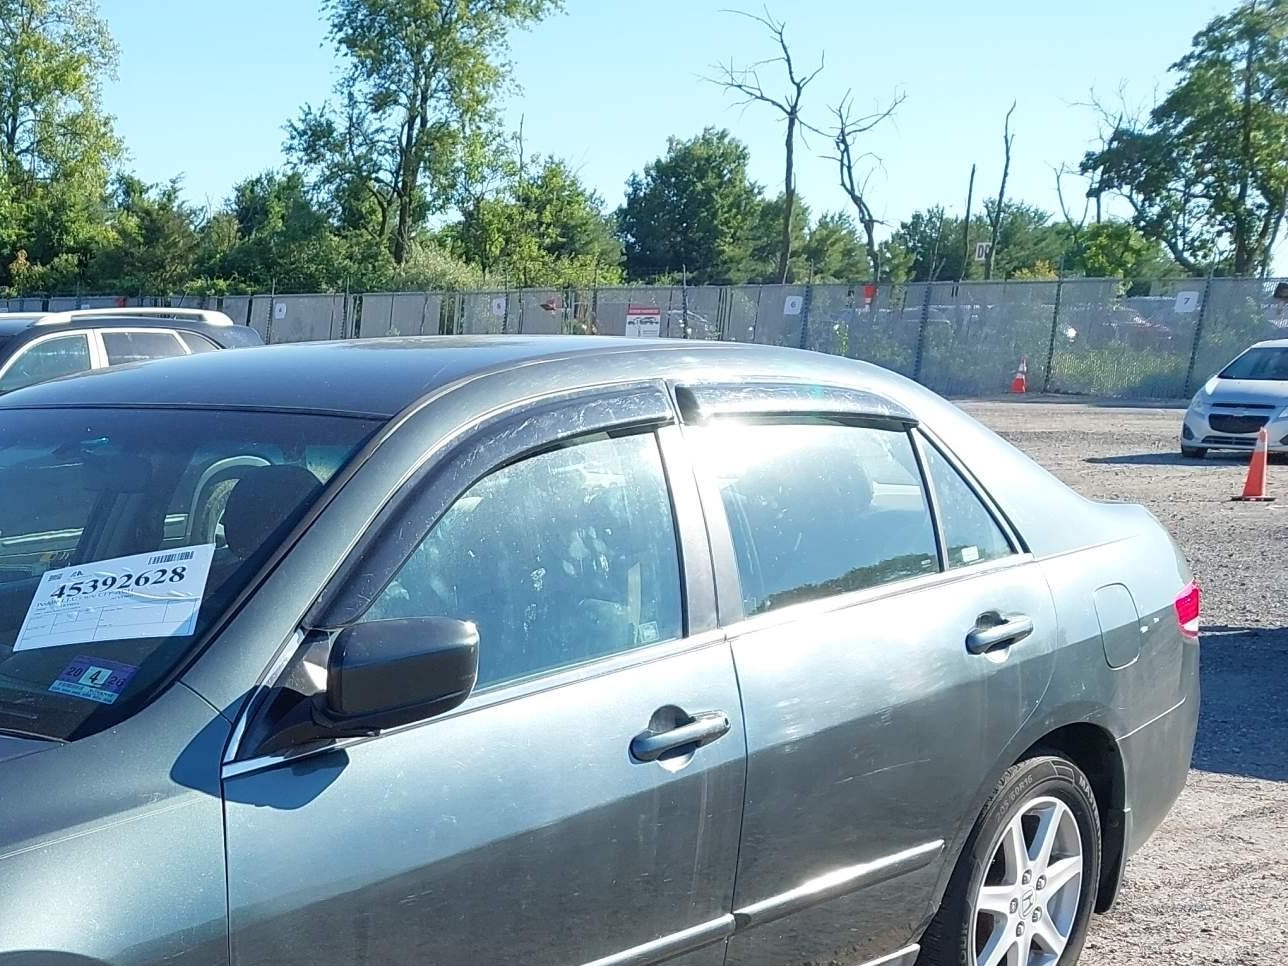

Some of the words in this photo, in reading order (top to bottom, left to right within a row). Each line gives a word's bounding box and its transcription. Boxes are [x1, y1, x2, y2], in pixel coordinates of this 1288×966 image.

[1183, 297, 1192, 305] 7
[50, 566, 187, 599] 45392628
[89, 670, 102, 684] 4
